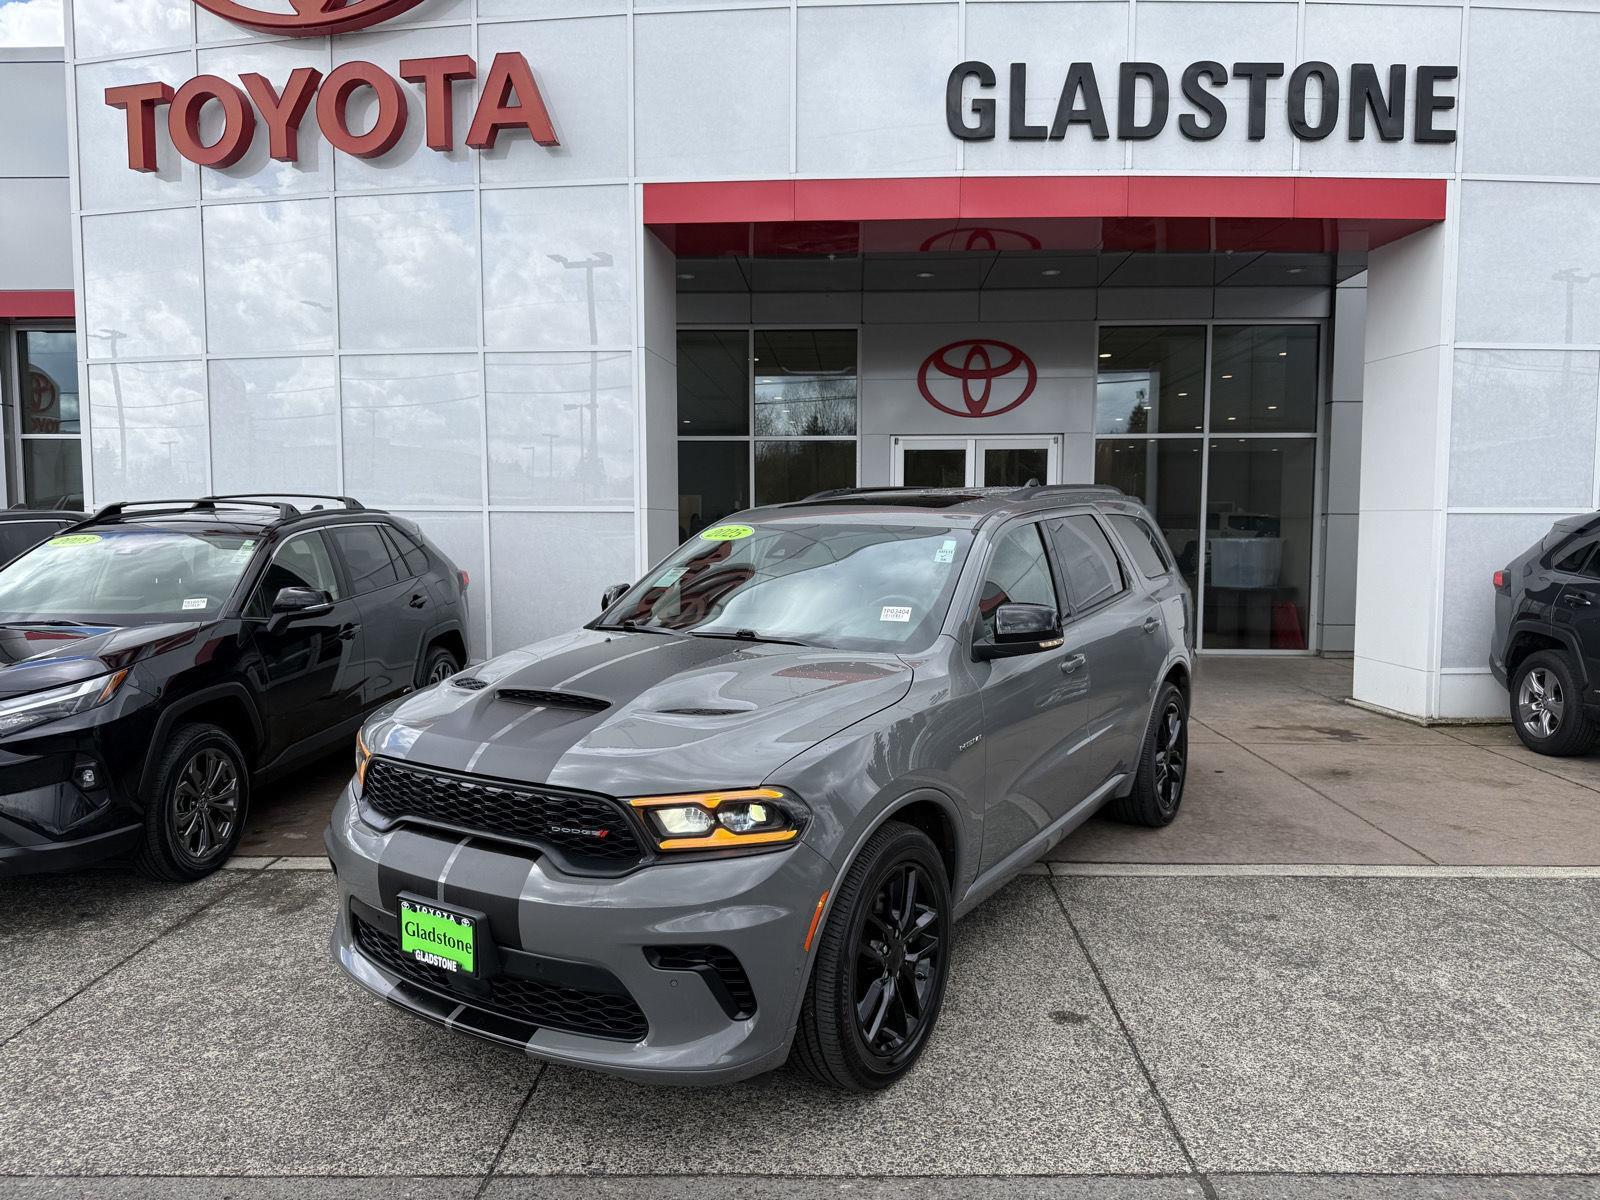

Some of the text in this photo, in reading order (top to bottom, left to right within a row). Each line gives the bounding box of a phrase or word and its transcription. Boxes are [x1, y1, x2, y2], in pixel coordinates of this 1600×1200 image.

[104, 51, 560, 173] TOYOTA
[945, 61, 1458, 143] GLADSTONE
[551, 826, 599, 836] DODGE
[415, 904, 456, 922] TOYOTA
[404, 921, 472, 955] Gladstone
[415, 949, 458, 972] GLADSTONE
